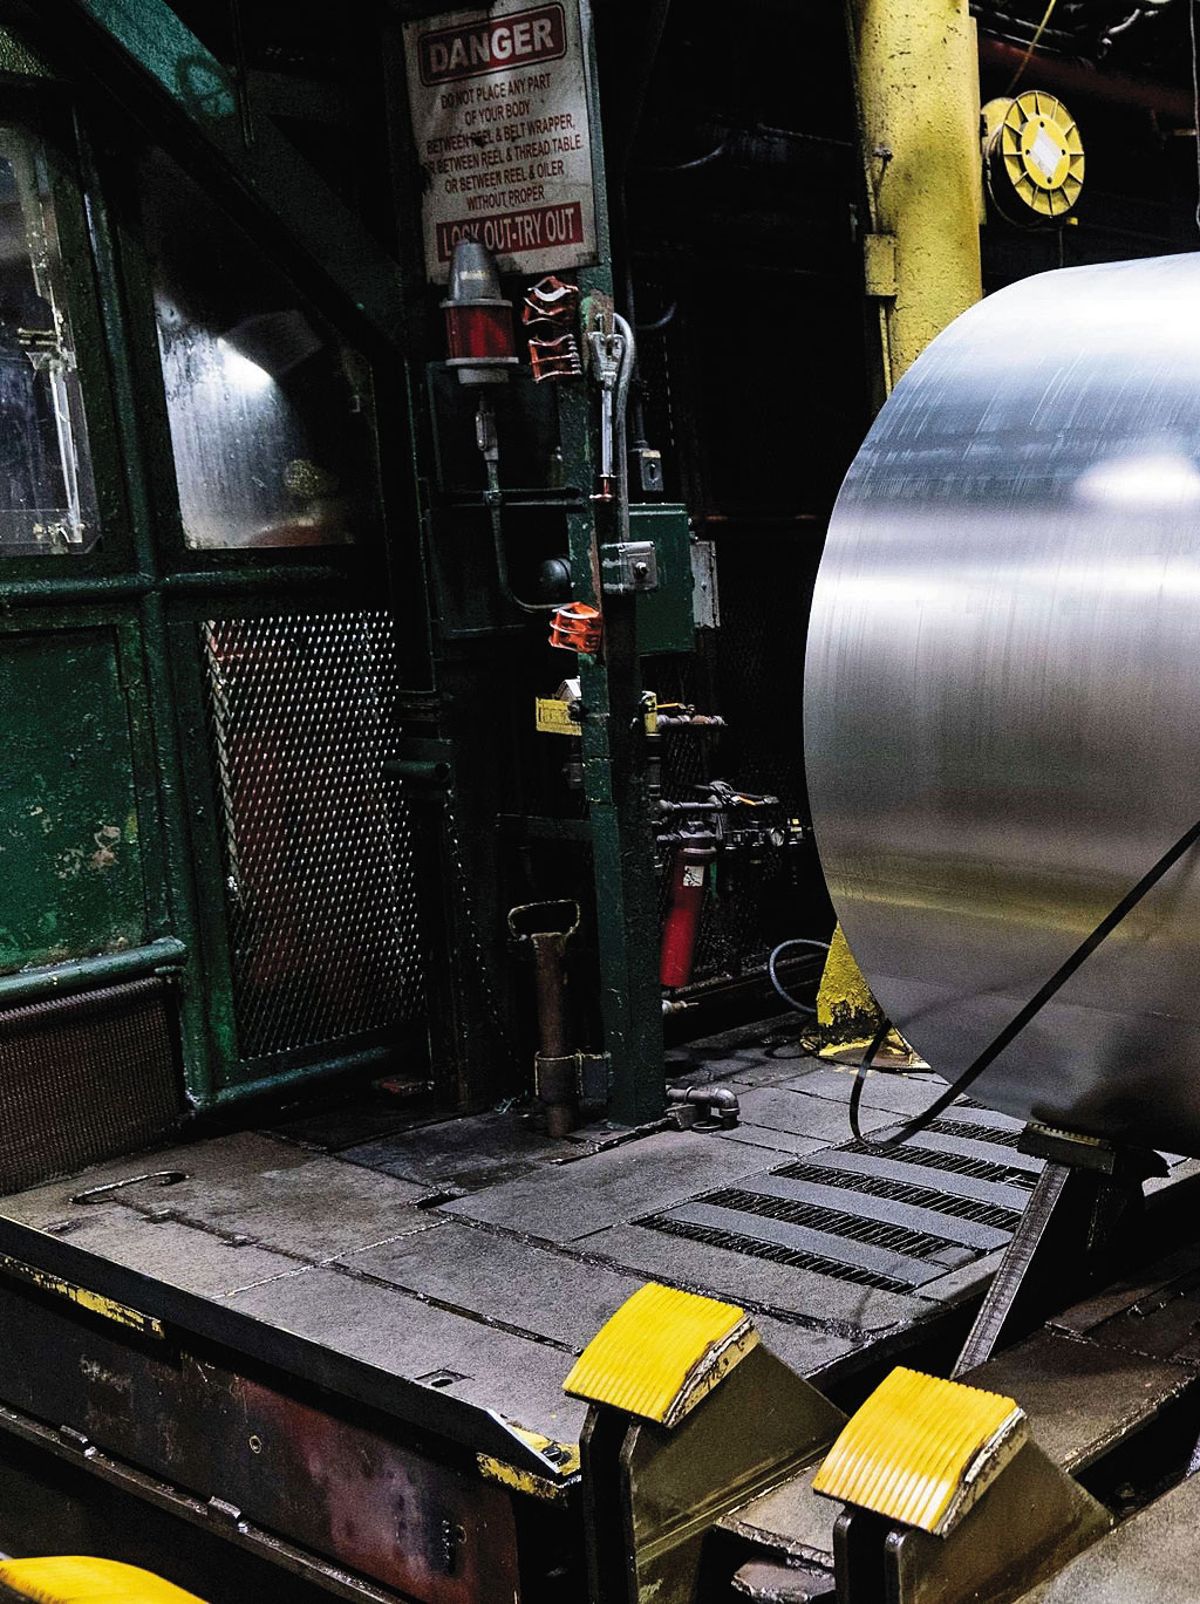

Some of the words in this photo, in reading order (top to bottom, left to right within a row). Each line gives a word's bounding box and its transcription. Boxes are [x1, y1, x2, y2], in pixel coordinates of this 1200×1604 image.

[429, 18, 554, 73] DANGER
[441, 92, 453, 110] DO
[454, 88, 474, 107] NOT
[476, 82, 505, 101] PLACE
[508, 78, 526, 95] ANY
[528, 73, 552, 91] PART
[465, 109, 477, 127] OF
[479, 104, 505, 123] YOUR
[506, 99, 530, 118] BODY
[427, 133, 468, 155] BETWEEN
[496, 127, 503, 143] &
[504, 123, 525, 142] BELT
[527, 113, 576, 136] WRAPPER,
[438, 152, 480, 175] BETWEEN
[481, 148, 504, 170] REEL
[506, 149, 513, 163] &
[515, 142, 550, 163] THREAD
[445, 175, 459, 194] OR
[461, 171, 502, 193] BETWEEN
[504, 167, 527, 184] REEL
[529, 164, 536, 180] &
[537, 159, 565, 179] OILER
[467, 190, 507, 212] WITHOUT
[509, 186, 545, 207] PROPER
[484, 213, 541, 251] OUT-TRY
[545, 207, 574, 242] OUT
